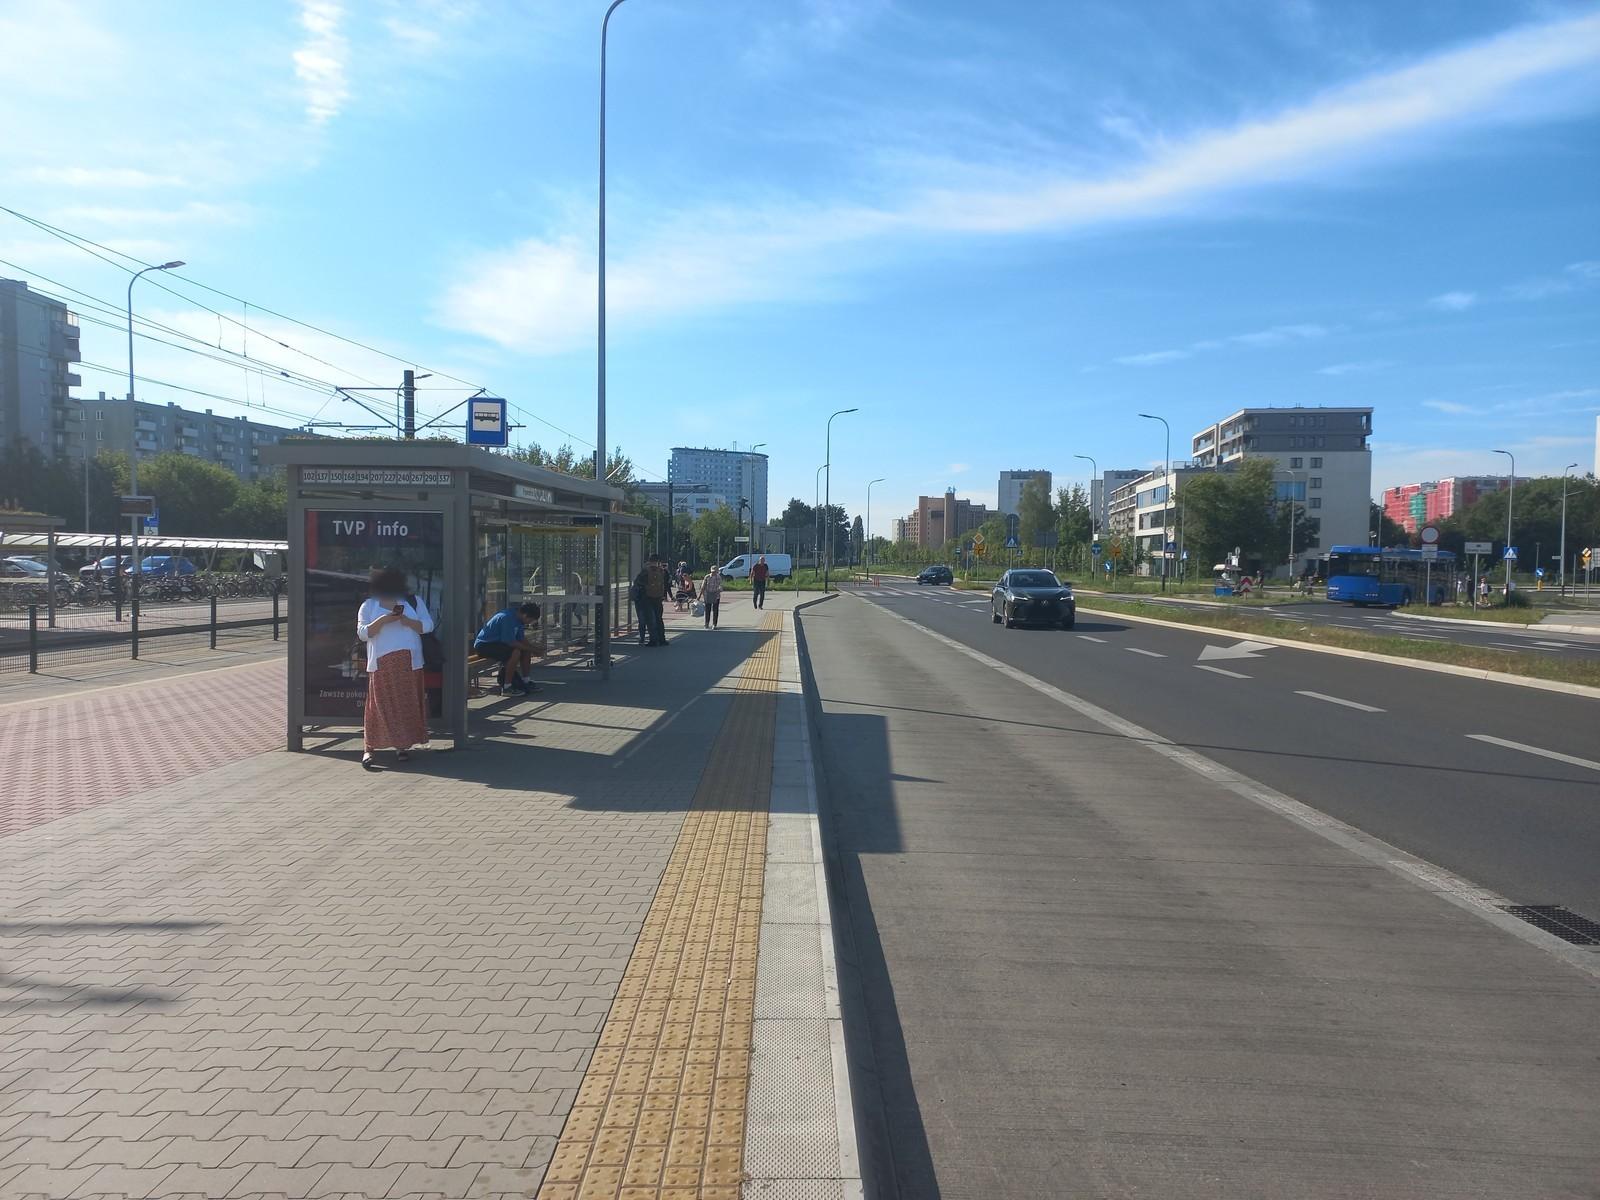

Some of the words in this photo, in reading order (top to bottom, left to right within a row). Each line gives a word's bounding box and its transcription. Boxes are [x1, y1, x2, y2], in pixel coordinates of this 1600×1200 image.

[384, 473, 396, 482] 227
[425, 474, 436, 482] 290
[332, 520, 366, 536] TVP
[377, 520, 408, 536] info
